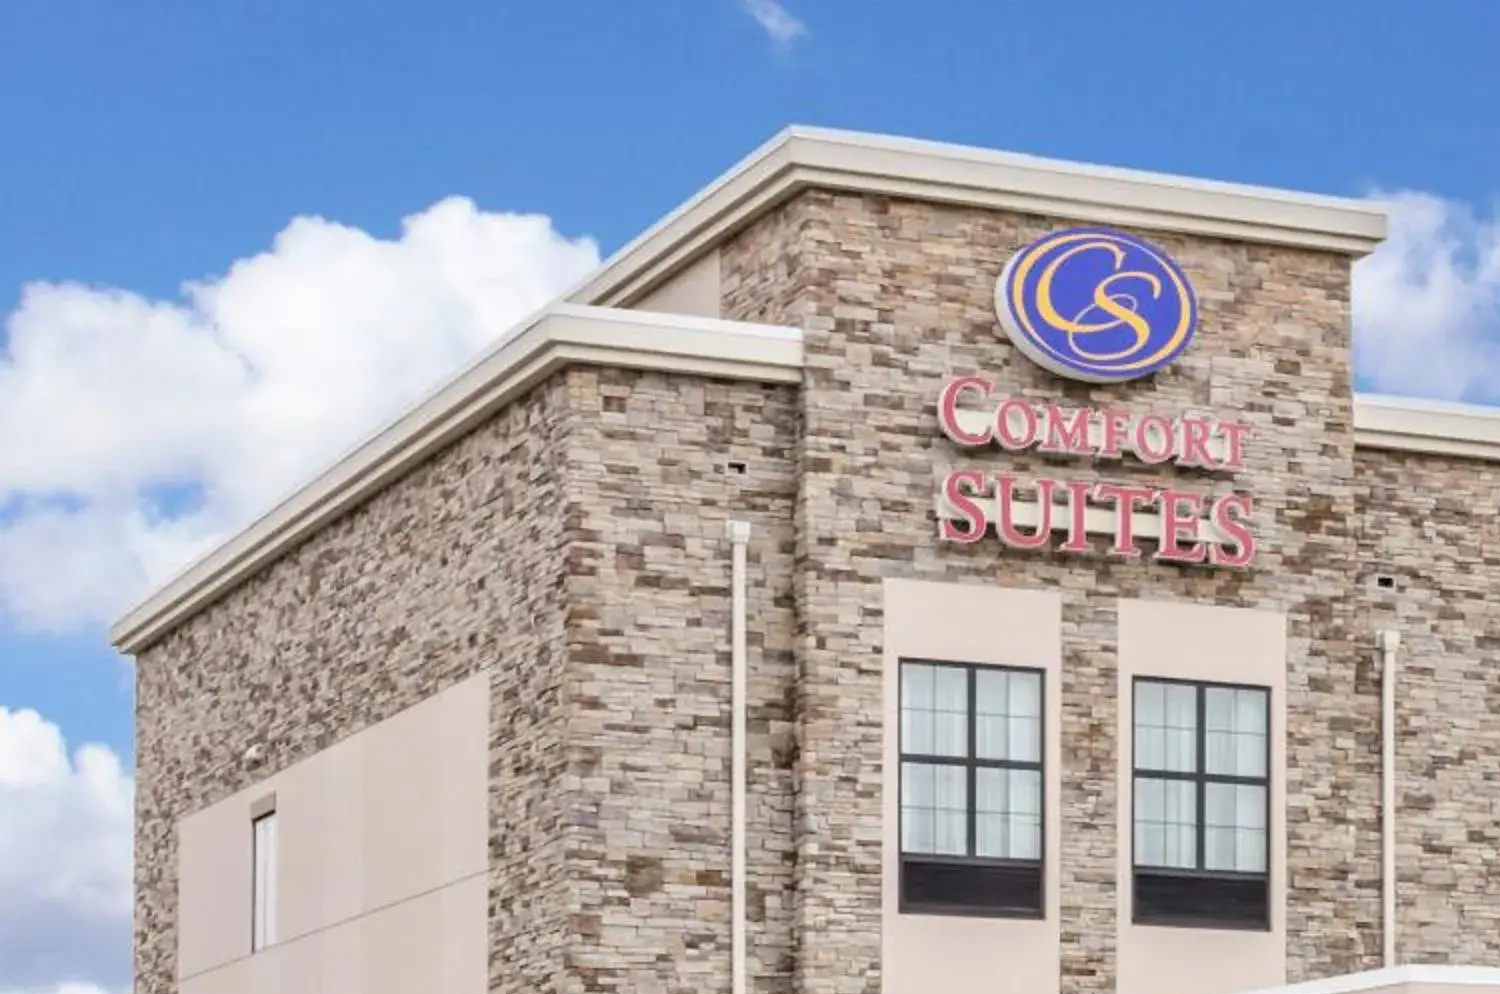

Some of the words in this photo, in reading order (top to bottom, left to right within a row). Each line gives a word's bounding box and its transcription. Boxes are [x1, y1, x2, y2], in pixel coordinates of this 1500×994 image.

[1036, 241, 1162, 361] CS
[937, 375, 1253, 471] COMFORT
[938, 468, 1257, 567] SUITES
